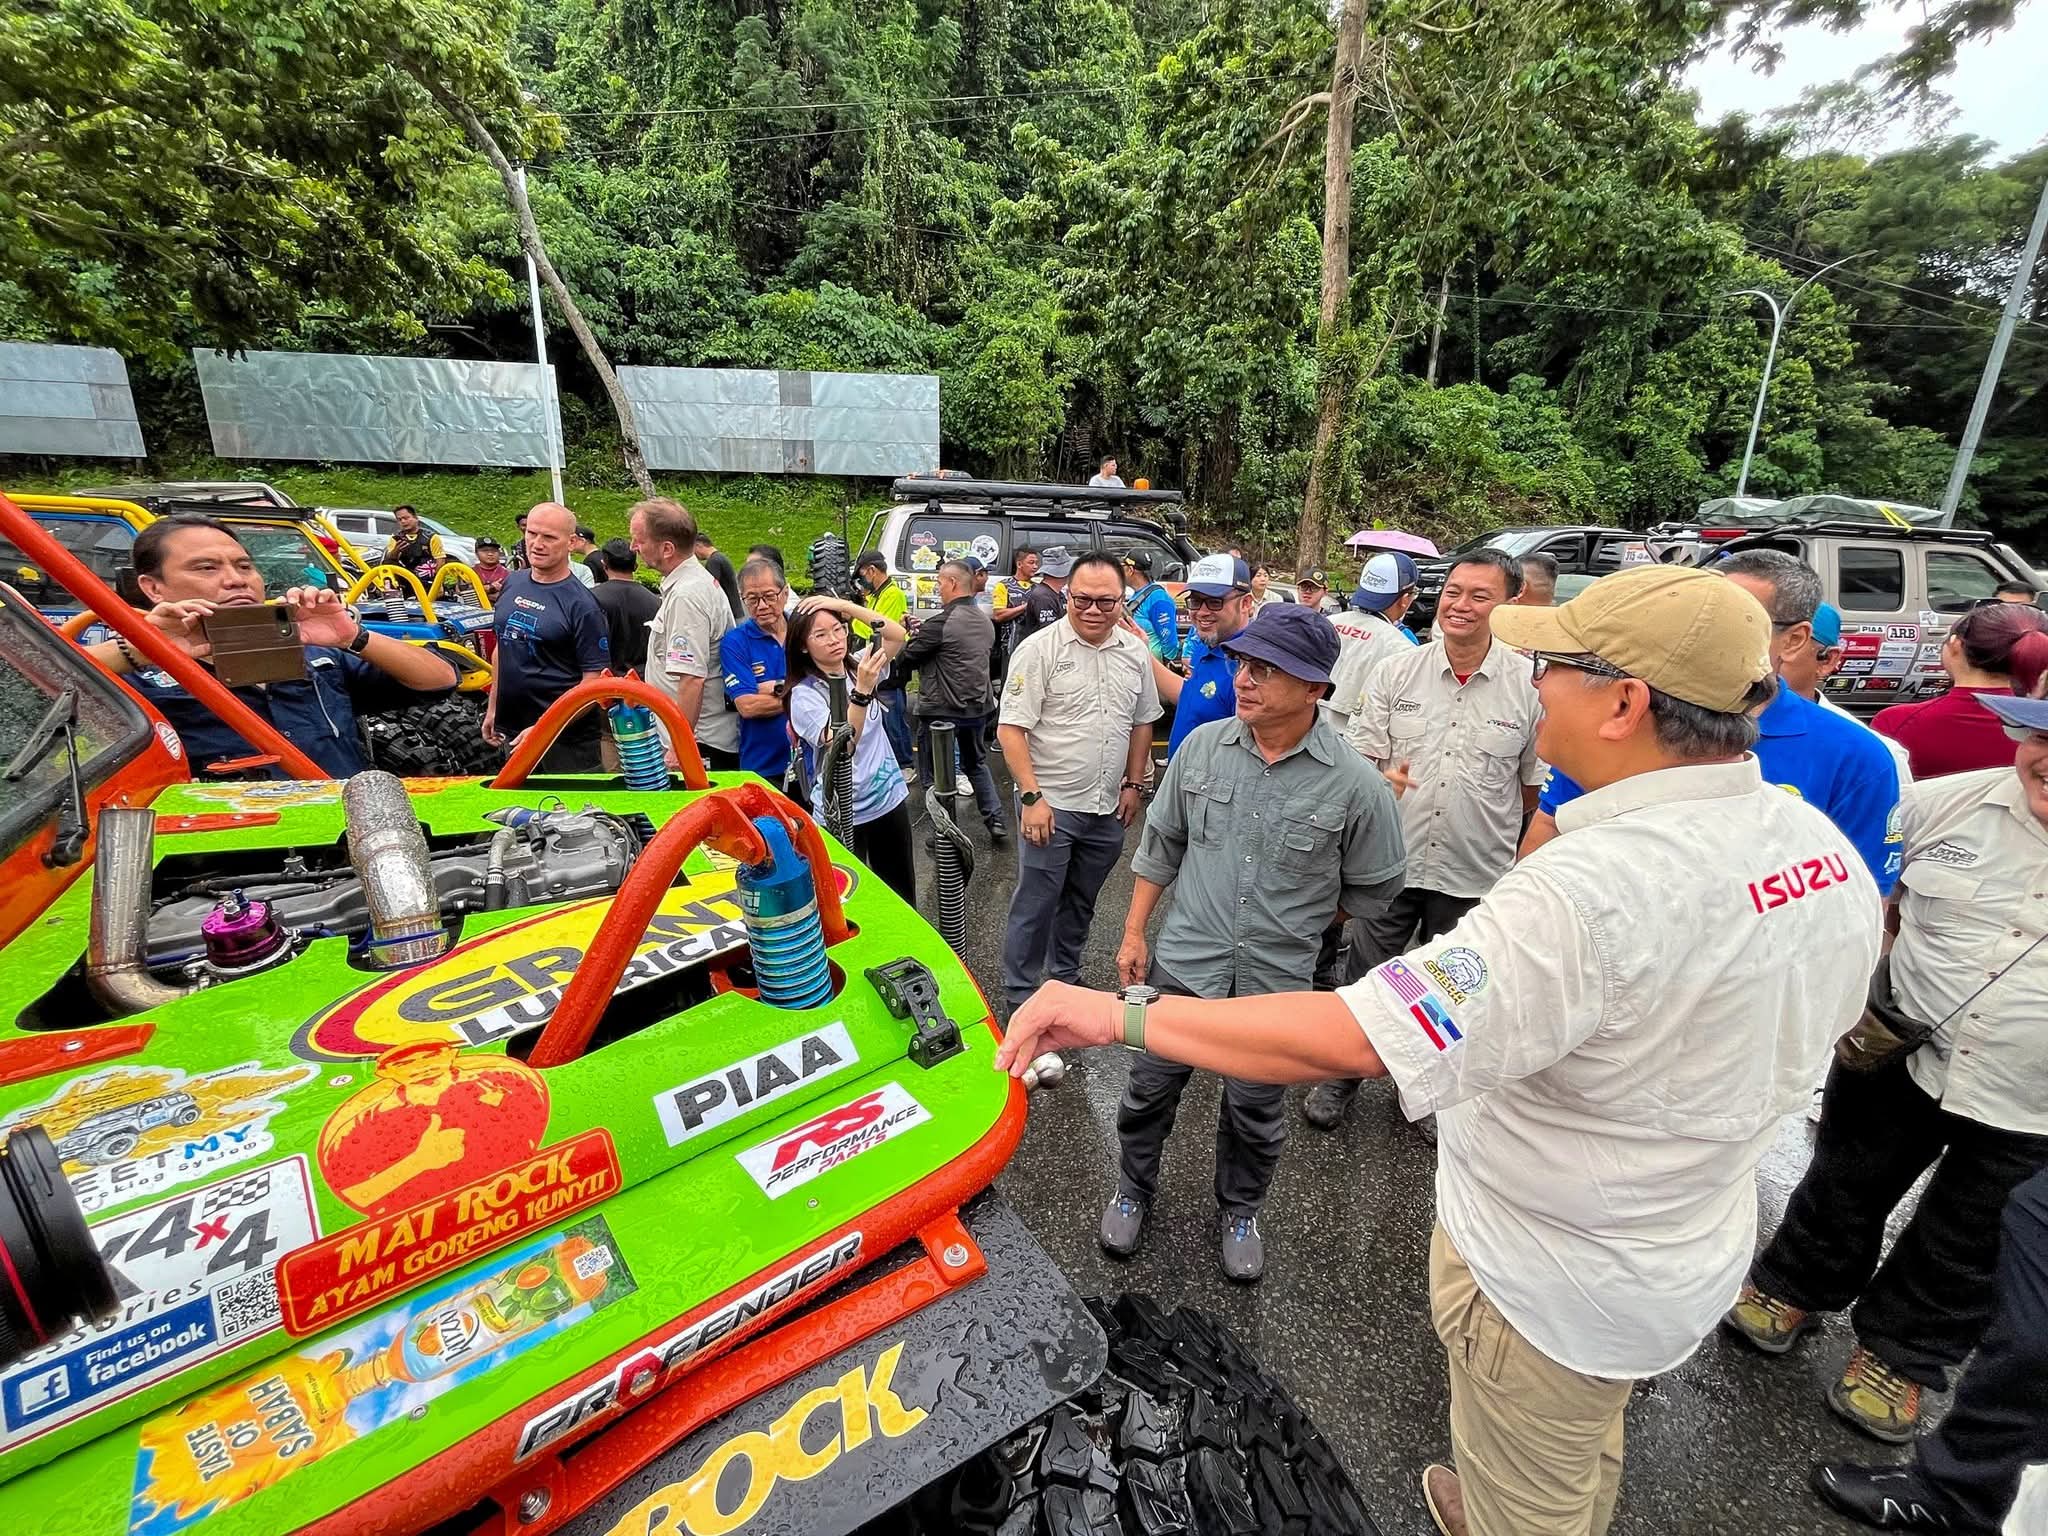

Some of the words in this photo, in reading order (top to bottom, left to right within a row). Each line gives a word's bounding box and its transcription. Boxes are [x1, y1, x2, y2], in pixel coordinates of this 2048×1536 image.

[1334, 623, 1373, 641] SUZU
[1889, 627, 1916, 640] ARB
[1747, 853, 1848, 914] ISUZU
[398, 889, 742, 1022] GRNT
[1423, 959, 1467, 1007] SABAH
[673, 1035, 843, 1131] PIAA
[763, 1090, 885, 1173] RS
[765, 1104, 918, 1190] PERFORMANCE
[818, 1130, 887, 1174] PARTS
[335, 1200, 446, 1276] MAT
[453, 1146, 581, 1225] ROCK
[306, 1266, 395, 1321] AYAM
[403, 1208, 519, 1274] GORENG
[526, 1168, 609, 1220] KUNYIT
[85, 1339, 122, 1367] Find
[127, 1334, 146, 1349] us
[150, 1321, 171, 1339] on
[88, 1322, 207, 1387] facebook
[517, 1232, 862, 1460] PROFENDER
[224, 1420, 261, 1449] OF
[247, 1374, 316, 1459] SABAH
[185, 1420, 234, 1482] TASTE
